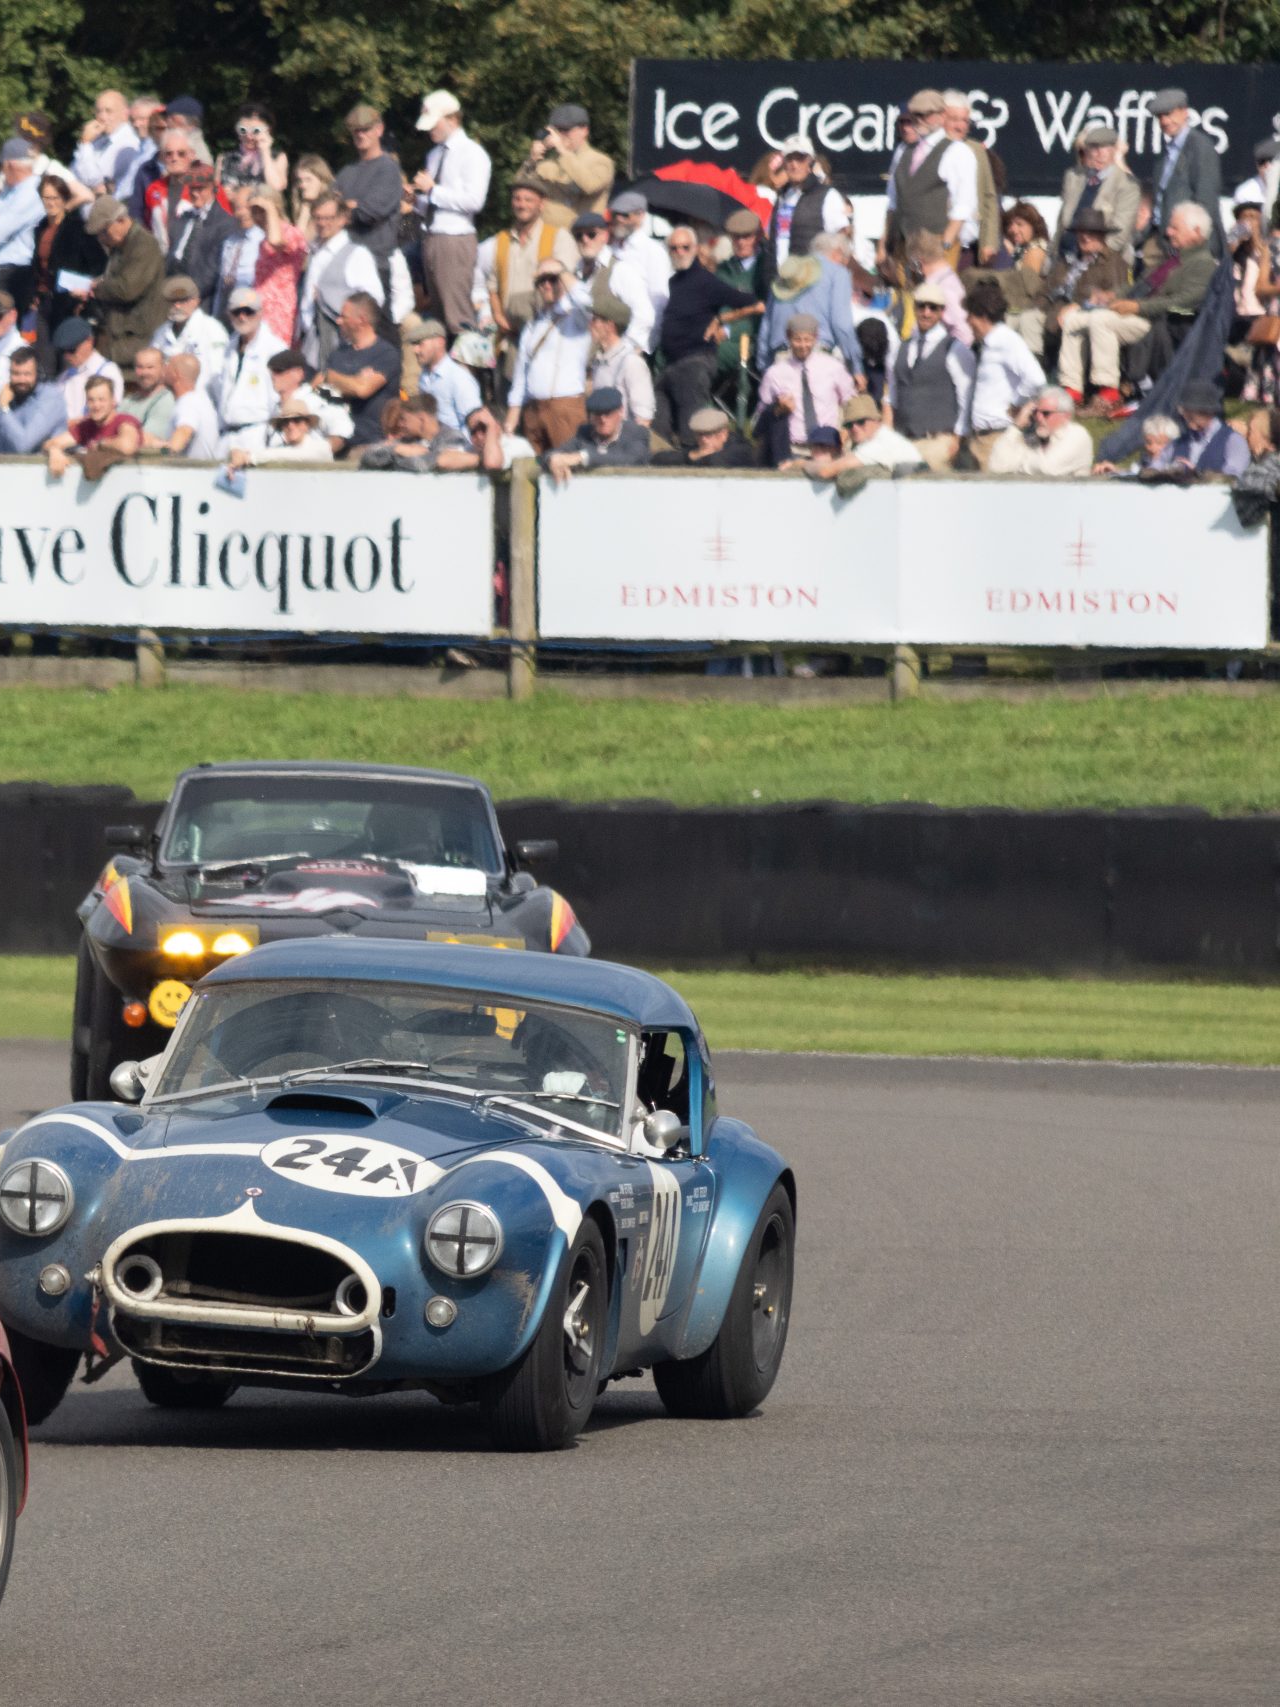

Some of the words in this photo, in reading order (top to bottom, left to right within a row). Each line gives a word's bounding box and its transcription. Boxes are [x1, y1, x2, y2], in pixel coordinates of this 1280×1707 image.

[653, 87, 740, 151] Ice
[110, 491, 416, 614] Clicquot
[620, 583, 819, 608] EDMISTON
[986, 589, 1178, 615] EDMISTON
[271, 1138, 419, 1193] 24A
